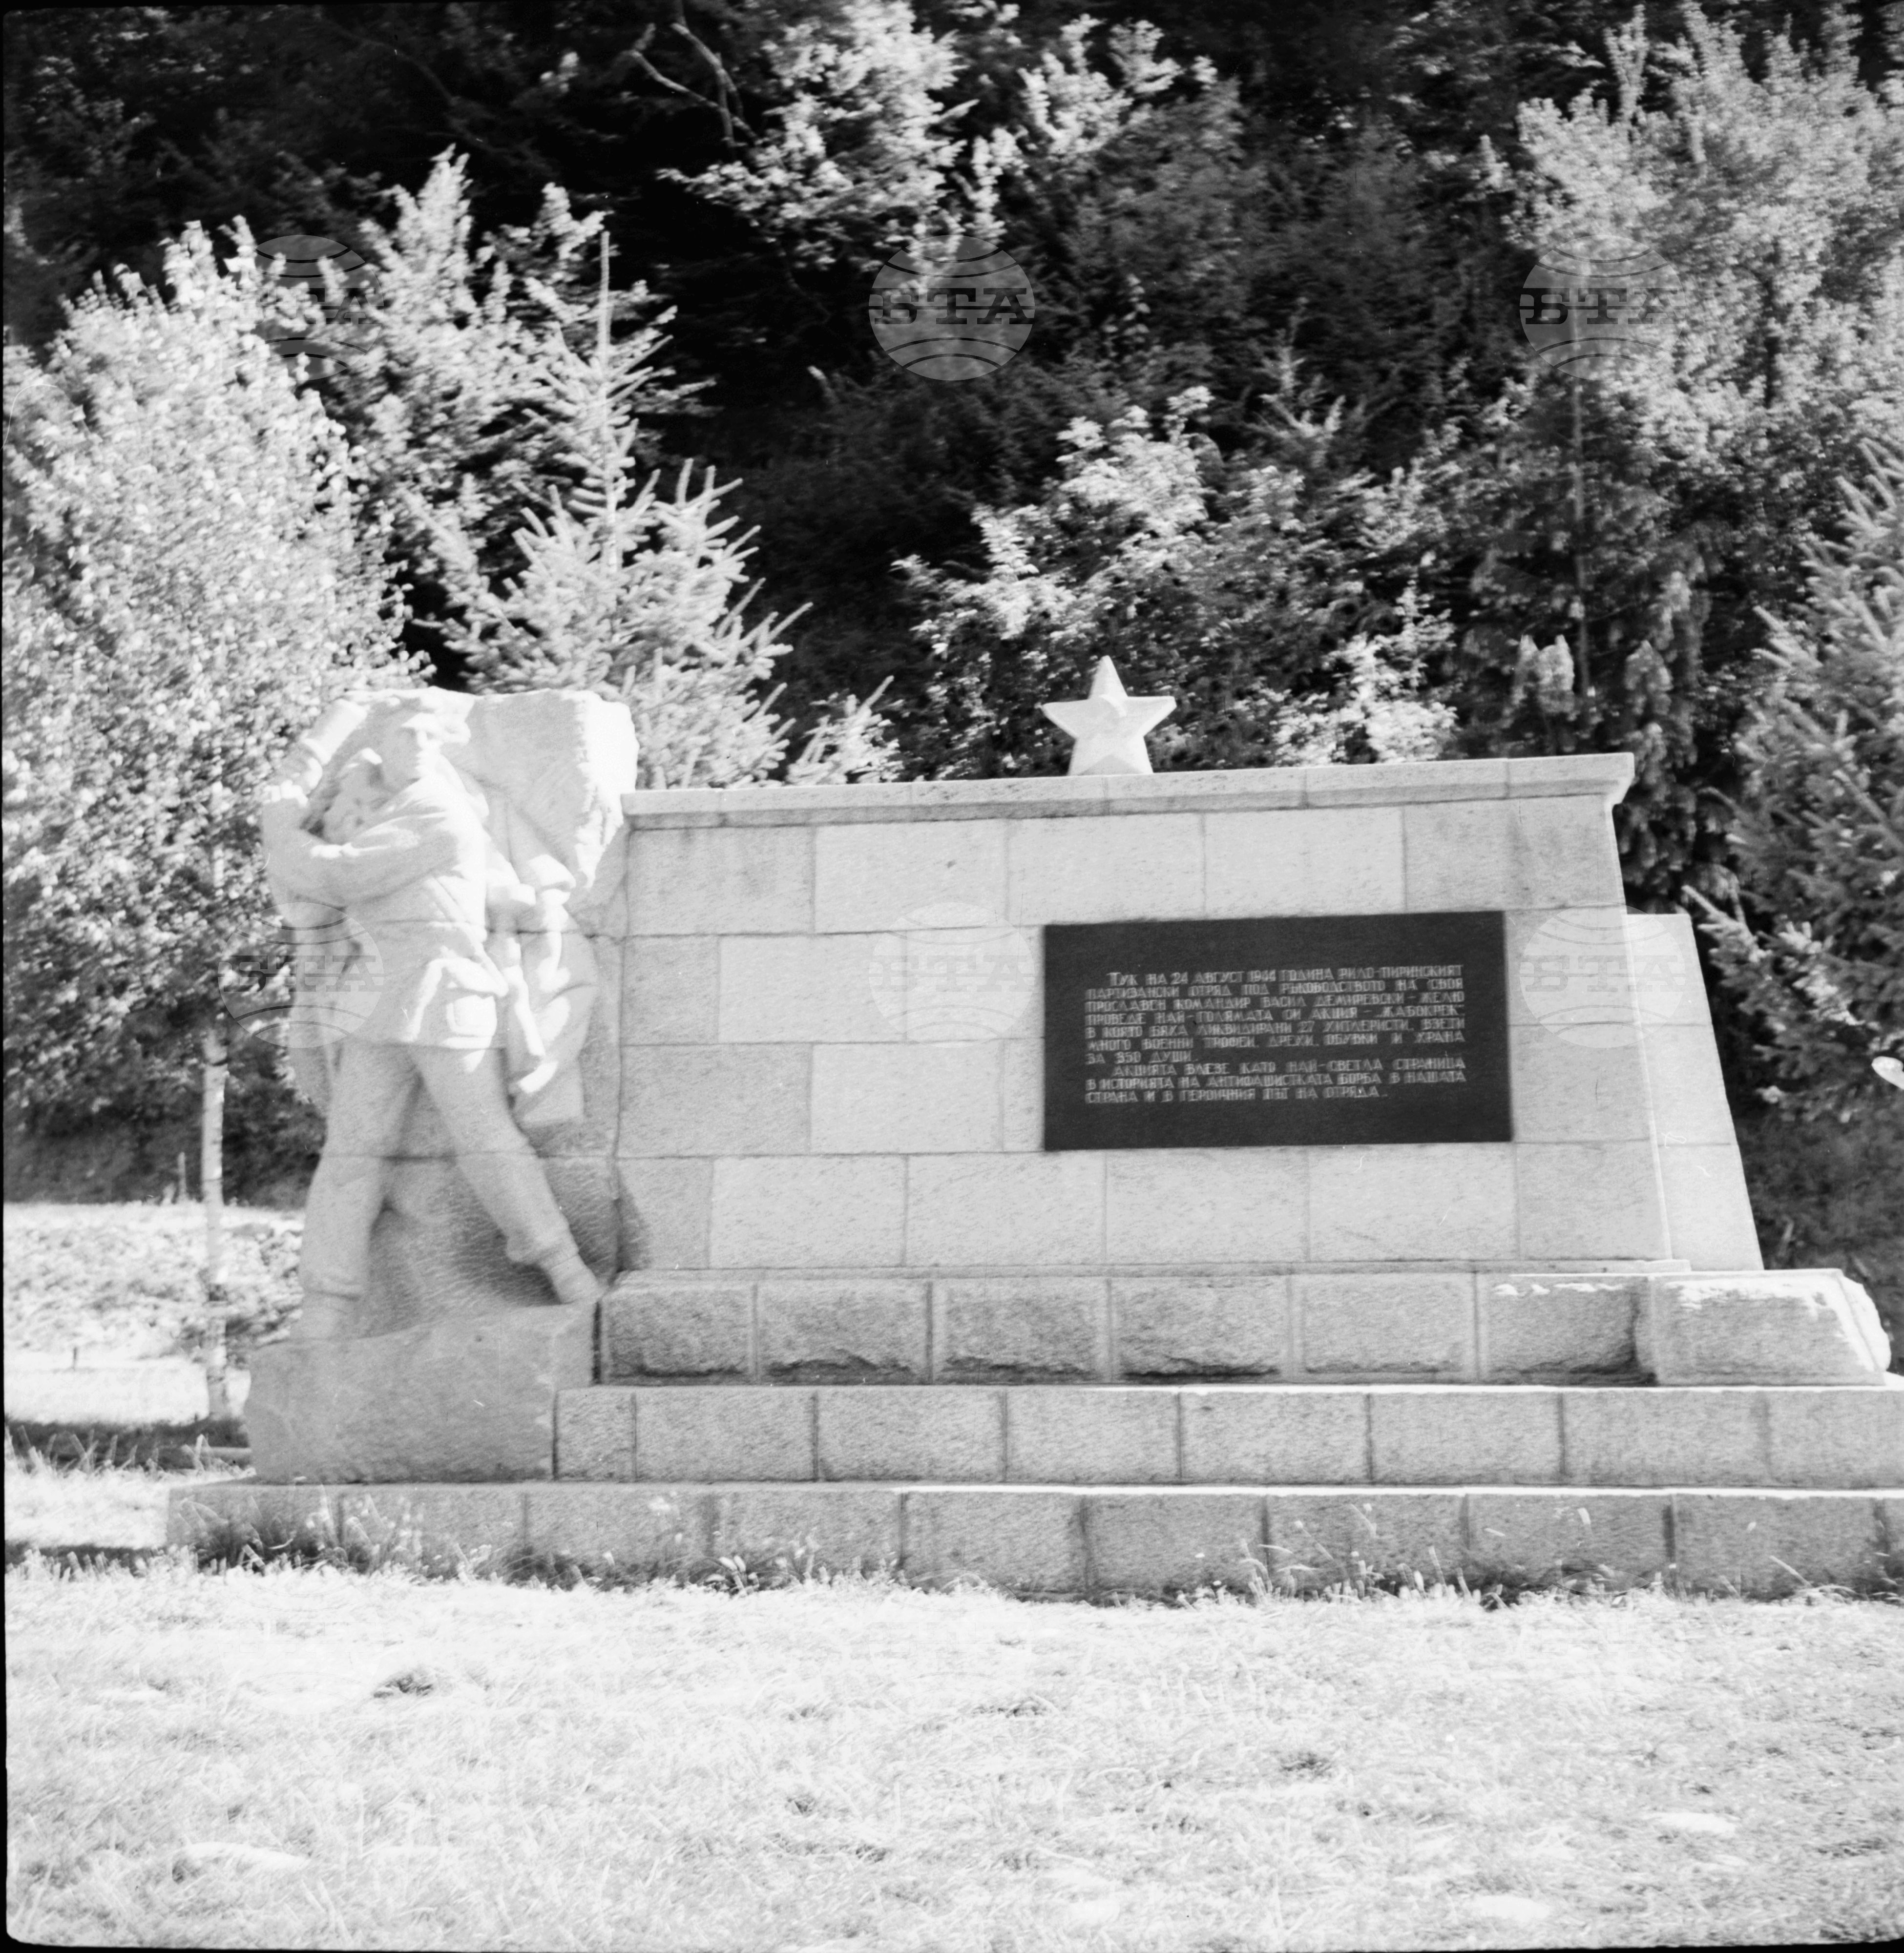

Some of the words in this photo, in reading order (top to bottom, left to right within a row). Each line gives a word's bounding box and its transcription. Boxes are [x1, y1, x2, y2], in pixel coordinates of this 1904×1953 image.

[1145, 973, 1168, 985] НА
[1170, 972, 1189, 984] 24
[1191, 971, 1245, 984] АВГУСТ
[1247, 969, 1276, 982] 1944
[1278, 968, 1335, 981] ГОДИНА
[1085, 986, 1179, 999] ПАРТИЗАНСКИ
[1188, 984, 1232, 997] ОТРЯД
[1241, 983, 1270, 995] ПОД
[1279, 980, 1385, 995] РЪКОВОДСТВОТО
[1395, 979, 1418, 991] НА
[1427, 977, 1463, 990] СВОЯ
[1085, 999, 1166, 1013] ПРОСЛАВЕН
[1173, 997, 1251, 1010] КОМАНДИР
[1260, 996, 1307, 1008] ВАСИЛ
[1313, 993, 1404, 1006] ДЕМИРЕВСКИ
[1419, 991, 1465, 1003] ЖЕЛЮ
[1085, 1013, 1146, 1026] ПРОВЕДЕ
[1282, 1008, 1301, 1020] СИ
[1308, 1007, 1357, 1019] АКЦИЯ
[1085, 1027, 1095, 1039] В
[1102, 1026, 1143, 1039] КОЯТО
[1149, 1025, 1189, 1037] БЯХА
[1196, 1022, 1292, 1036] ЛИКВИДИРАНИ
[1297, 1020, 1315, 1033] 27
[1421, 1017, 1465, 1030] ВЗЕТИ
[1086, 1039, 1131, 1051] МНОГО
[1141, 1038, 1193, 1049] ВОЕННИ
[1323, 1033, 1378, 1045] ОБУВКИ
[1391, 1032, 1402, 1044] И
[1415, 1030, 1465, 1043] ХРАНА
[1085, 1053, 1106, 1065] ЗА
[1114, 1051, 1141, 1064] 350
[1111, 1064, 1177, 1077] АКЦИЯТА
[1184, 1063, 1230, 1075] ВЛЕЗЕ
[1239, 1061, 1276, 1074] КАТО
[1392, 1057, 1466, 1070] СТРАНИЦА
[1086, 1079, 1096, 1091] В
[1099, 1077, 1174, 1090] ИСТОРИЯТА
[1177, 1076, 1200, 1088] НА
[1337, 1072, 1382, 1085] БОРБА
[1389, 1072, 1400, 1083] В
[1404, 1070, 1466, 1083] НАШАТА
[1085, 1091, 1138, 1103] СТРАНА
[1143, 1091, 1155, 1102] И
[1161, 1090, 1173, 1102] В
[1262, 1087, 1290, 1100] ПЪТ
[1295, 1087, 1318, 1099] НА
